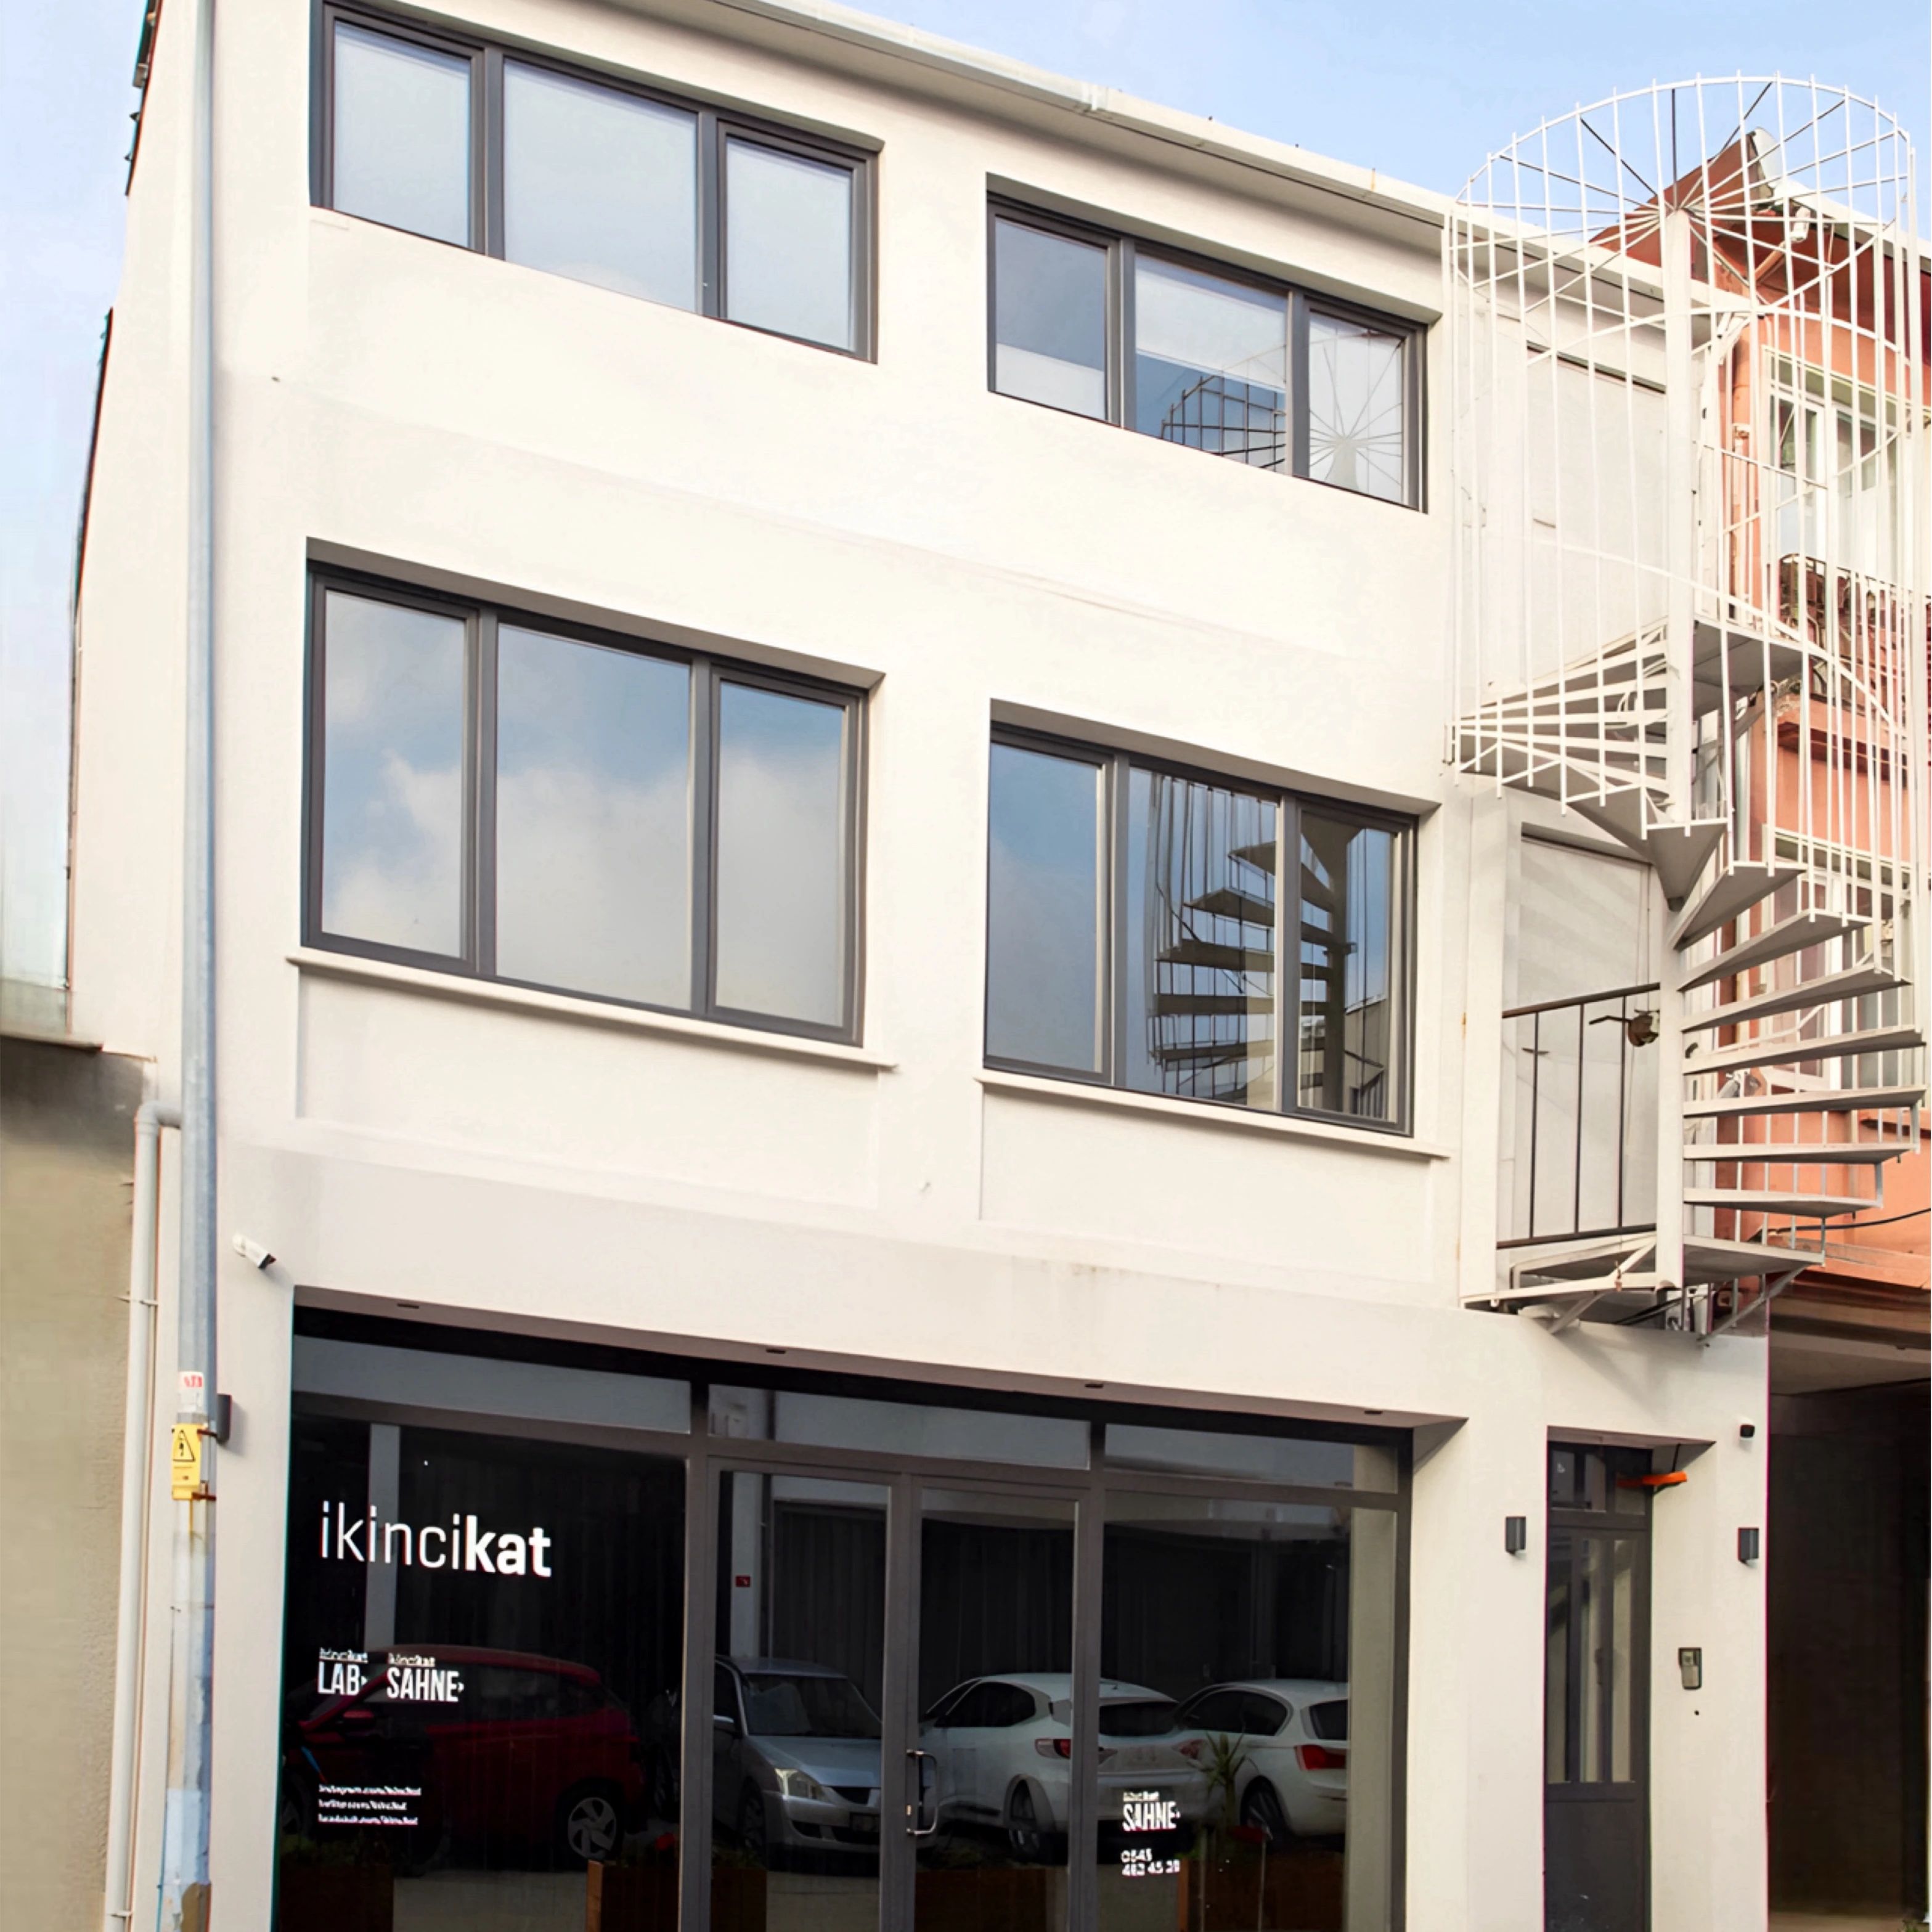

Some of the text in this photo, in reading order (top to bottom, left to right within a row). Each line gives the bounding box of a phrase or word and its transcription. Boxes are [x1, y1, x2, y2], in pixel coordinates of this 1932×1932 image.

[320, 1500, 552, 1578] ikincikat
[318, 1661, 360, 1696] LAB
[387, 1667, 460, 1702] SAHNE
[1122, 1801, 1176, 1832] SAHNE
